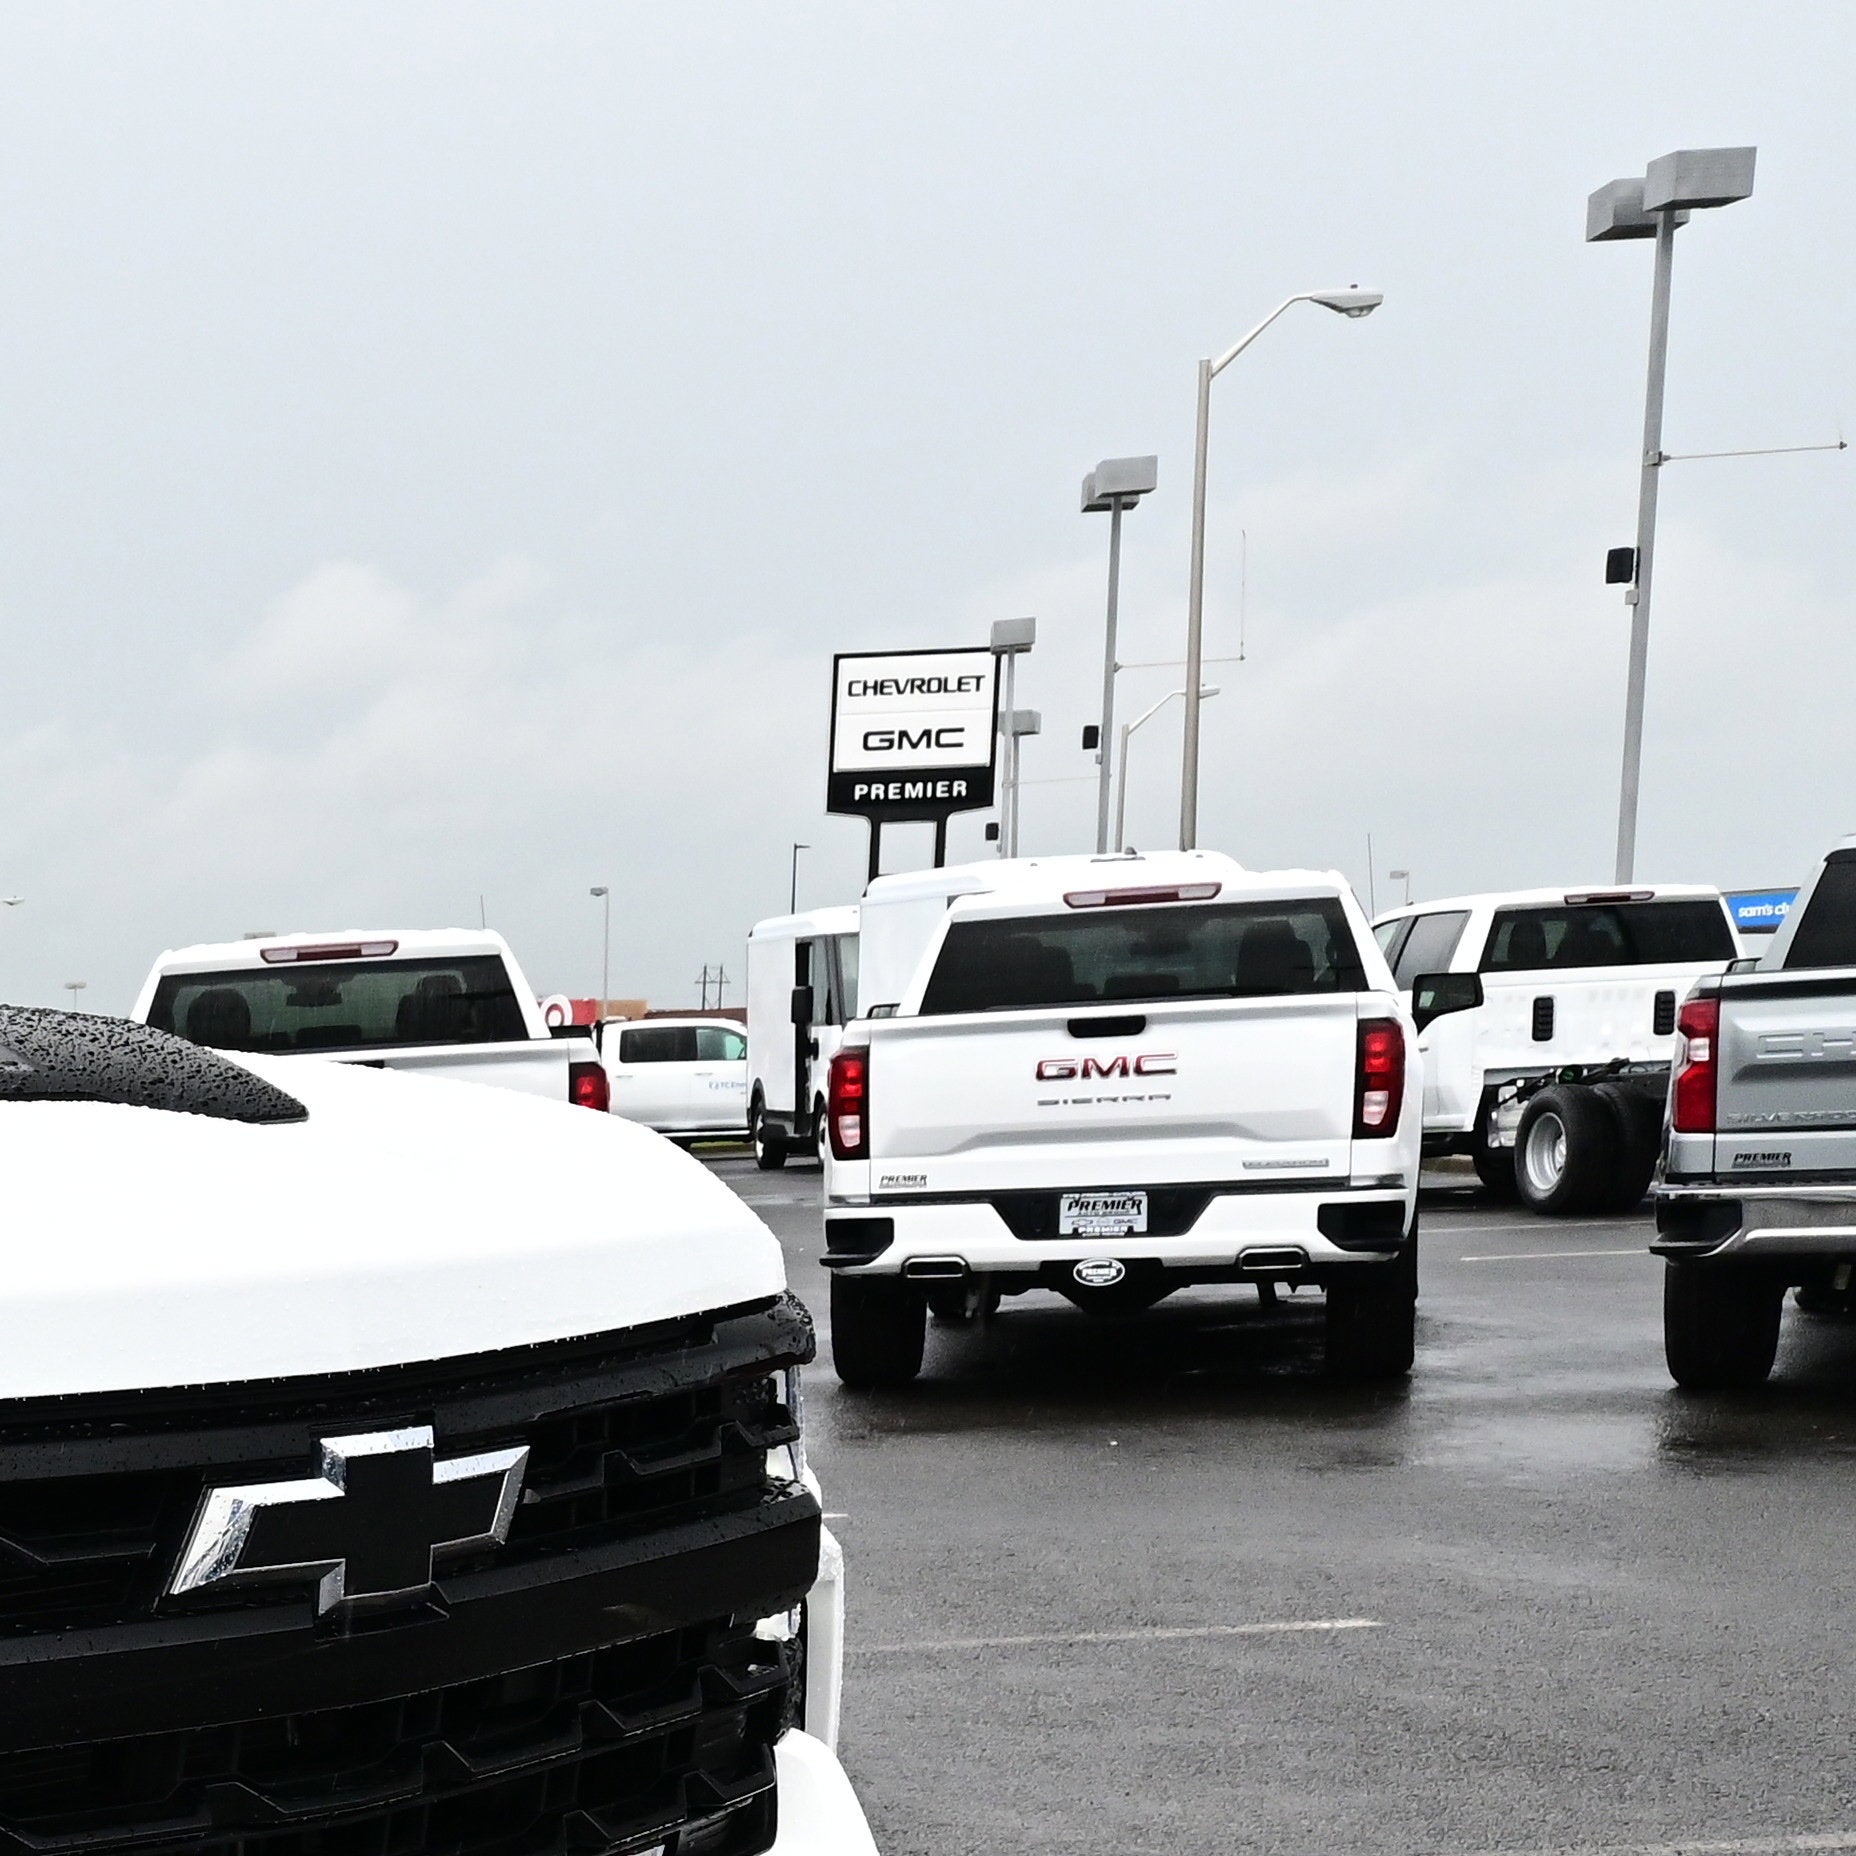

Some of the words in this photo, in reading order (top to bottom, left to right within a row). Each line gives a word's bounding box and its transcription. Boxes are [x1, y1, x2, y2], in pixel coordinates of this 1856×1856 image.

[847, 675, 986, 698] CHEVROLET
[862, 727, 965, 751] GMC
[854, 780, 967, 800] PREMIER
[1739, 905, 1773, 917] sam's
[1036, 1053, 1178, 1081] GMC
[1734, 1152, 1792, 1165] PREMIER
[881, 1174, 927, 1186] PREMIER
[1067, 1199, 1142, 1215] PREMIER
